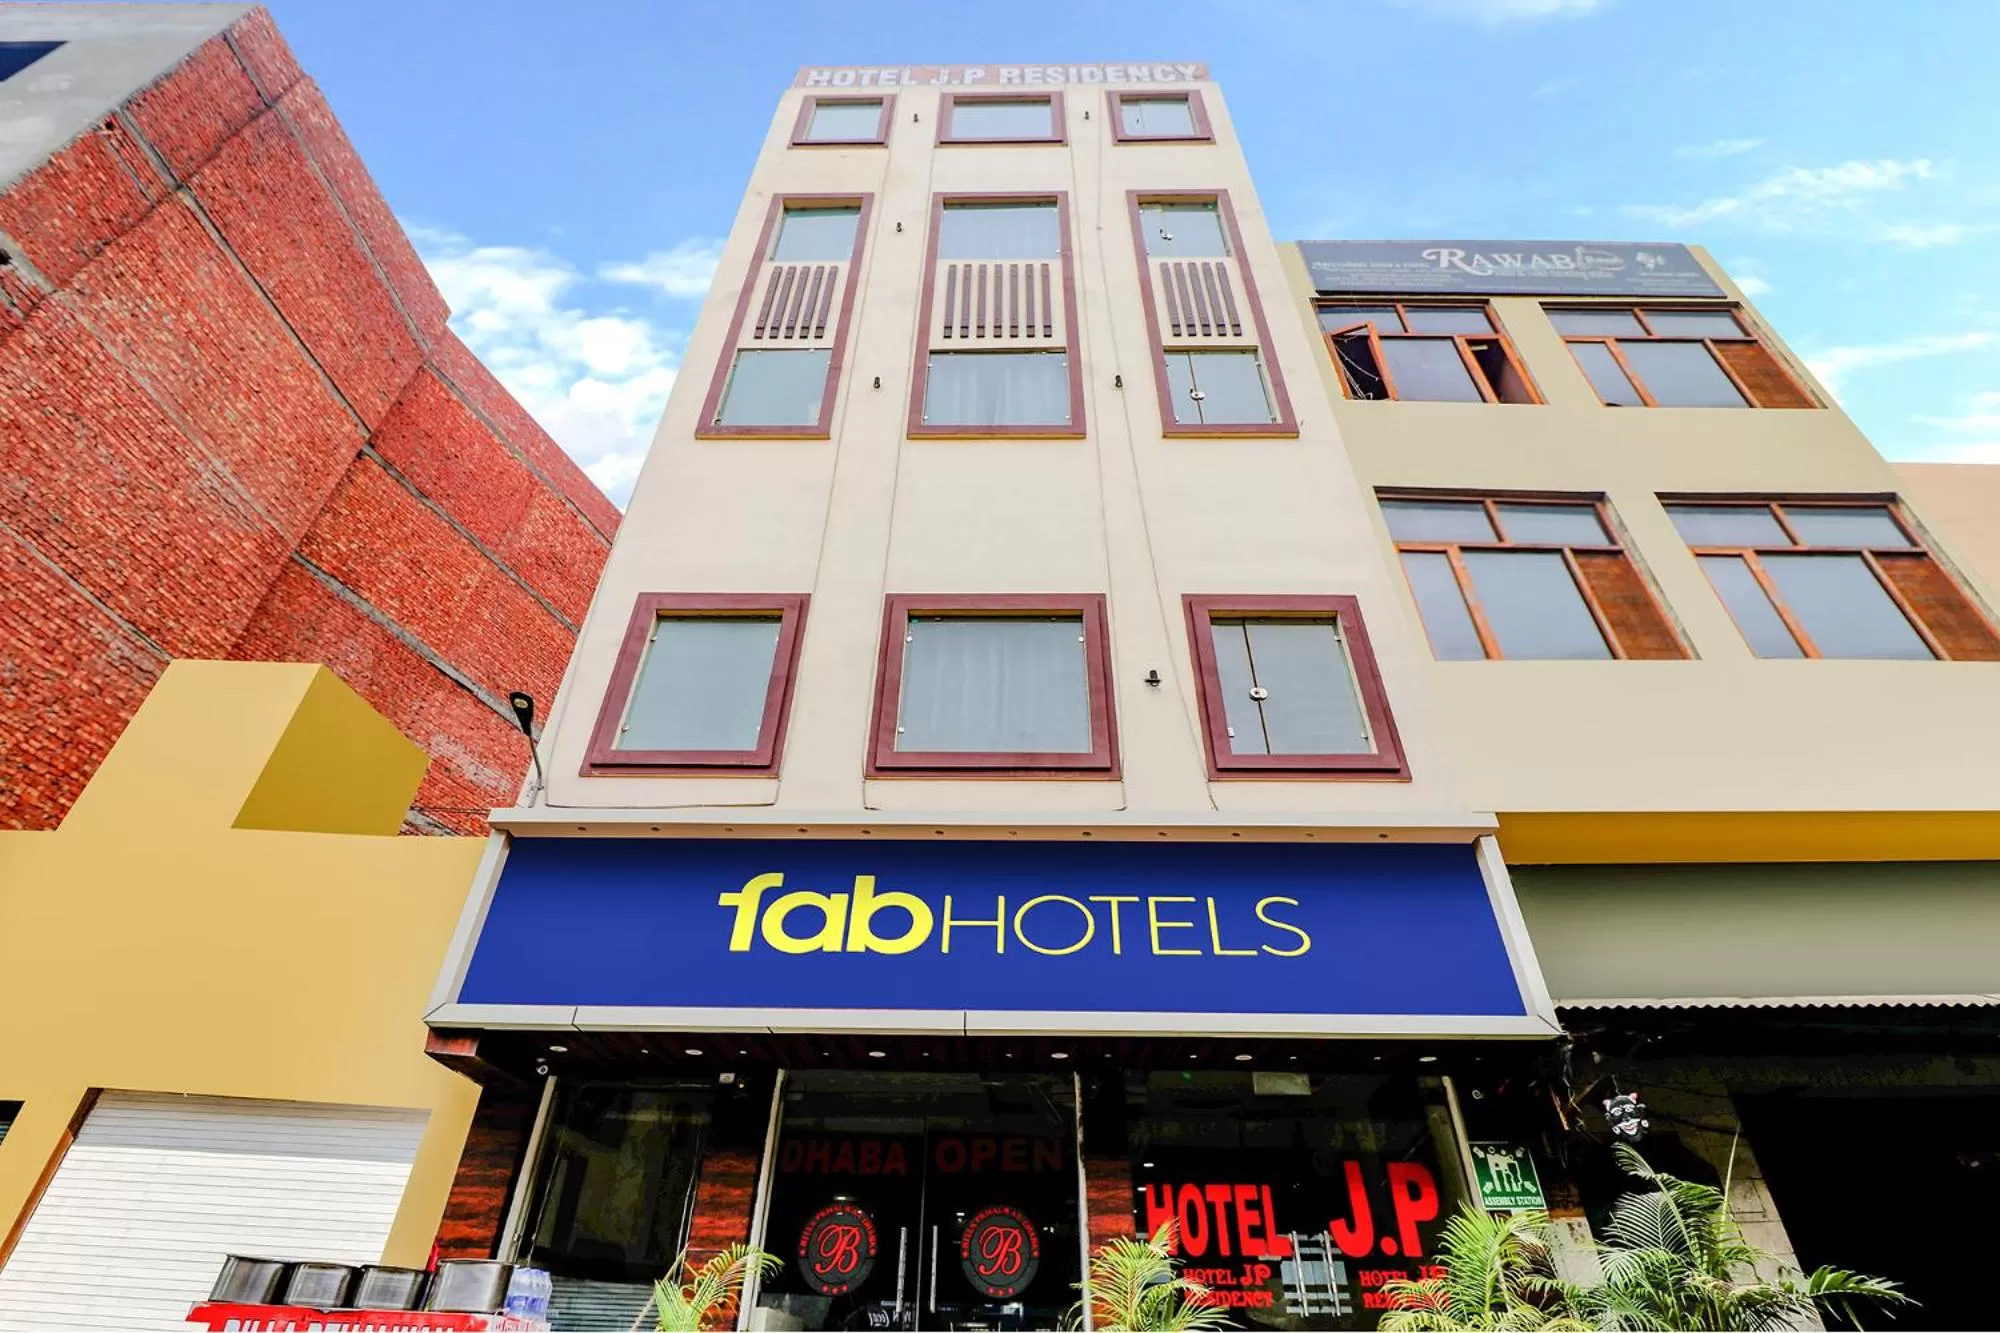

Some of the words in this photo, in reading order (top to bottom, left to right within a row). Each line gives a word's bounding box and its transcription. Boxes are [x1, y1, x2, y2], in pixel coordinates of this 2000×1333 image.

[806, 67, 917, 87] HOTEL
[930, 67, 985, 85] J.P
[1001, 63, 1197, 84] RESIDENCY
[782, 1139, 908, 1175] DHABA
[935, 1138, 1063, 1173] OPEN
[1145, 1183, 1293, 1258] HOTEL
[1329, 1160, 1439, 1258] J.P
[1484, 1196, 1515, 1206] ASSEMBLY
[1516, 1195, 1544, 1206] STATION
[815, 1224, 861, 1275] B
[977, 1225, 1023, 1276] B
[1183, 1268, 1237, 1285] HOTEL
[1240, 1263, 1272, 1287] JP
[1184, 1290, 1274, 1308] SIDENCY
